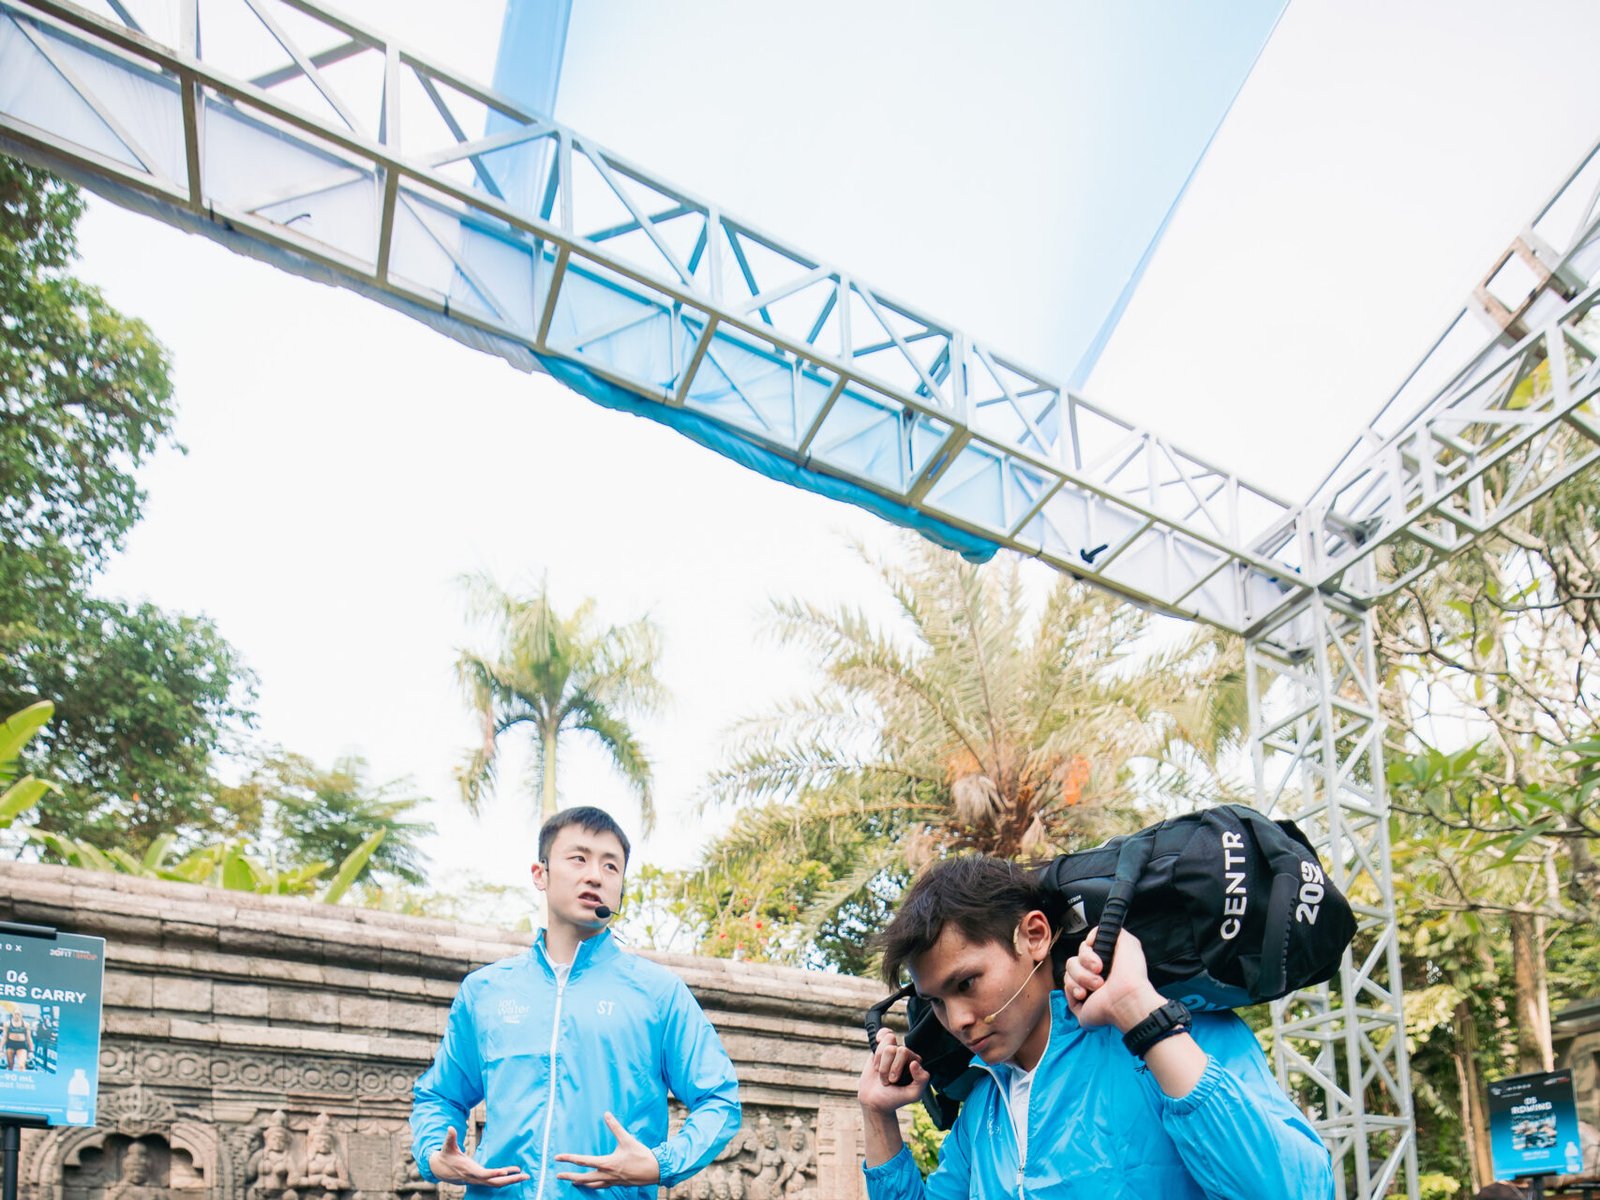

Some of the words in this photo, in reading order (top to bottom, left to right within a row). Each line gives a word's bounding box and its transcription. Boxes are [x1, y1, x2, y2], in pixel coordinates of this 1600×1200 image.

[1220, 830, 1247, 941] CENTR
[6, 970, 29, 984] 06
[31, 987, 87, 1004] CARRY
[596, 1000, 615, 1016] ST
